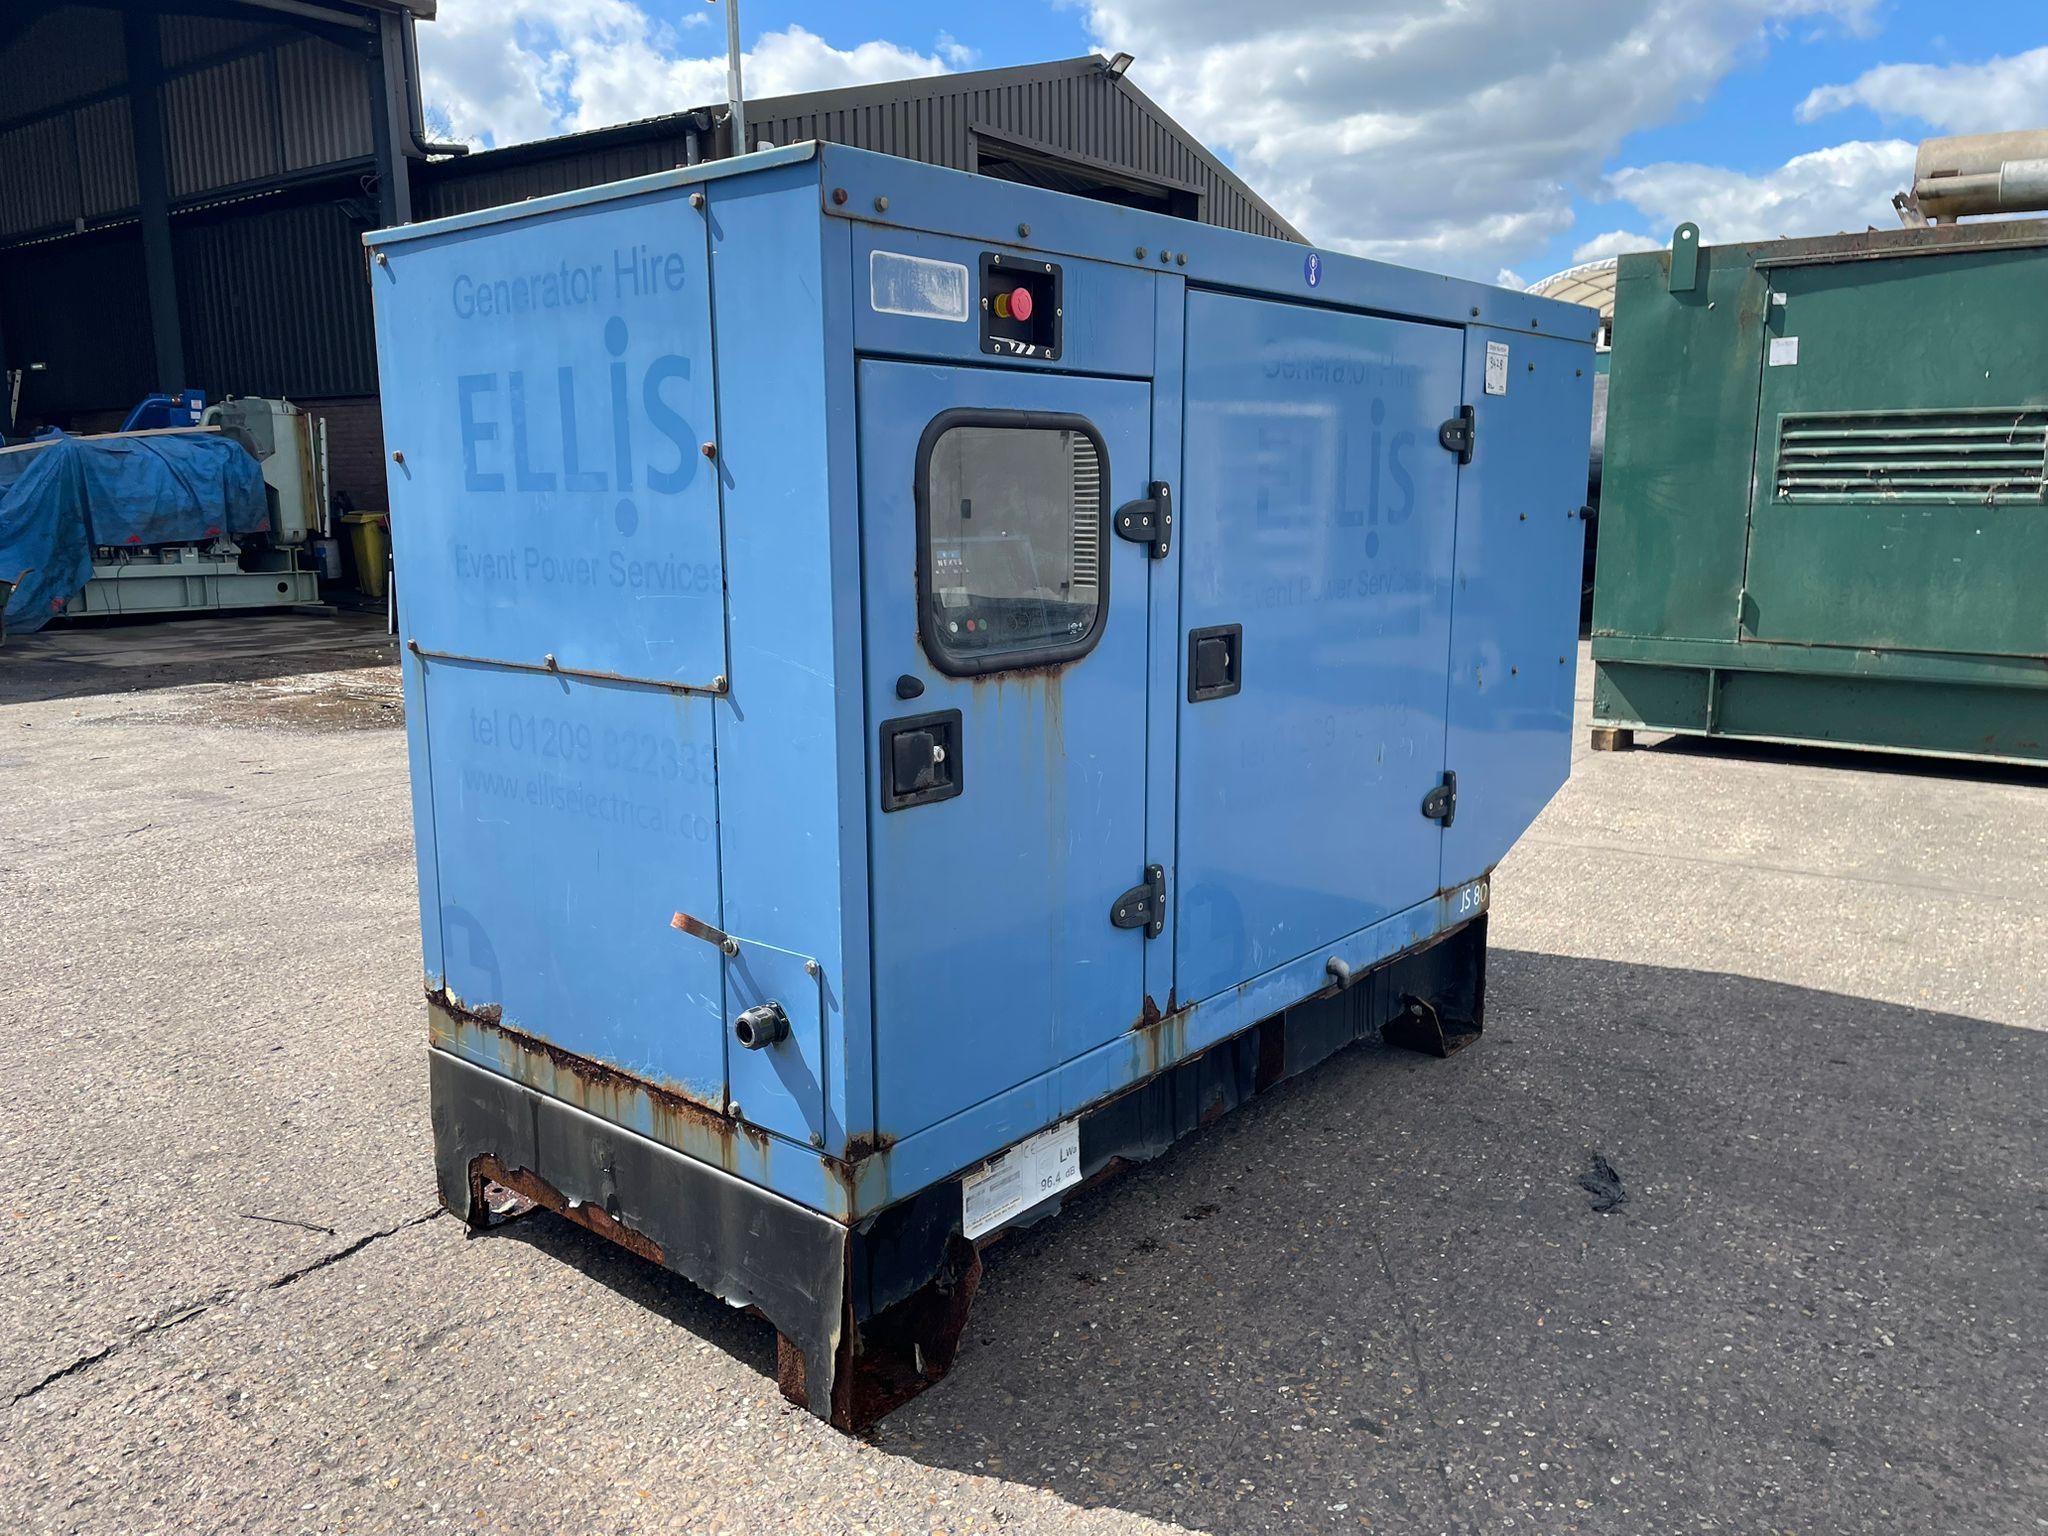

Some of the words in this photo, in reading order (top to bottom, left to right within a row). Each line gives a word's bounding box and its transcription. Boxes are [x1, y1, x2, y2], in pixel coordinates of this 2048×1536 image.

[452, 259, 602, 319] Generator
[614, 244, 686, 299] Hire
[454, 543, 518, 582] Event
[524, 546, 600, 586] Power
[609, 550, 723, 593] Services
[469, 707, 501, 748] tel
[1473, 882, 1488, 906] 80
[1040, 1171, 1062, 1192] 96.4
[1065, 1165, 1076, 1178] dB
